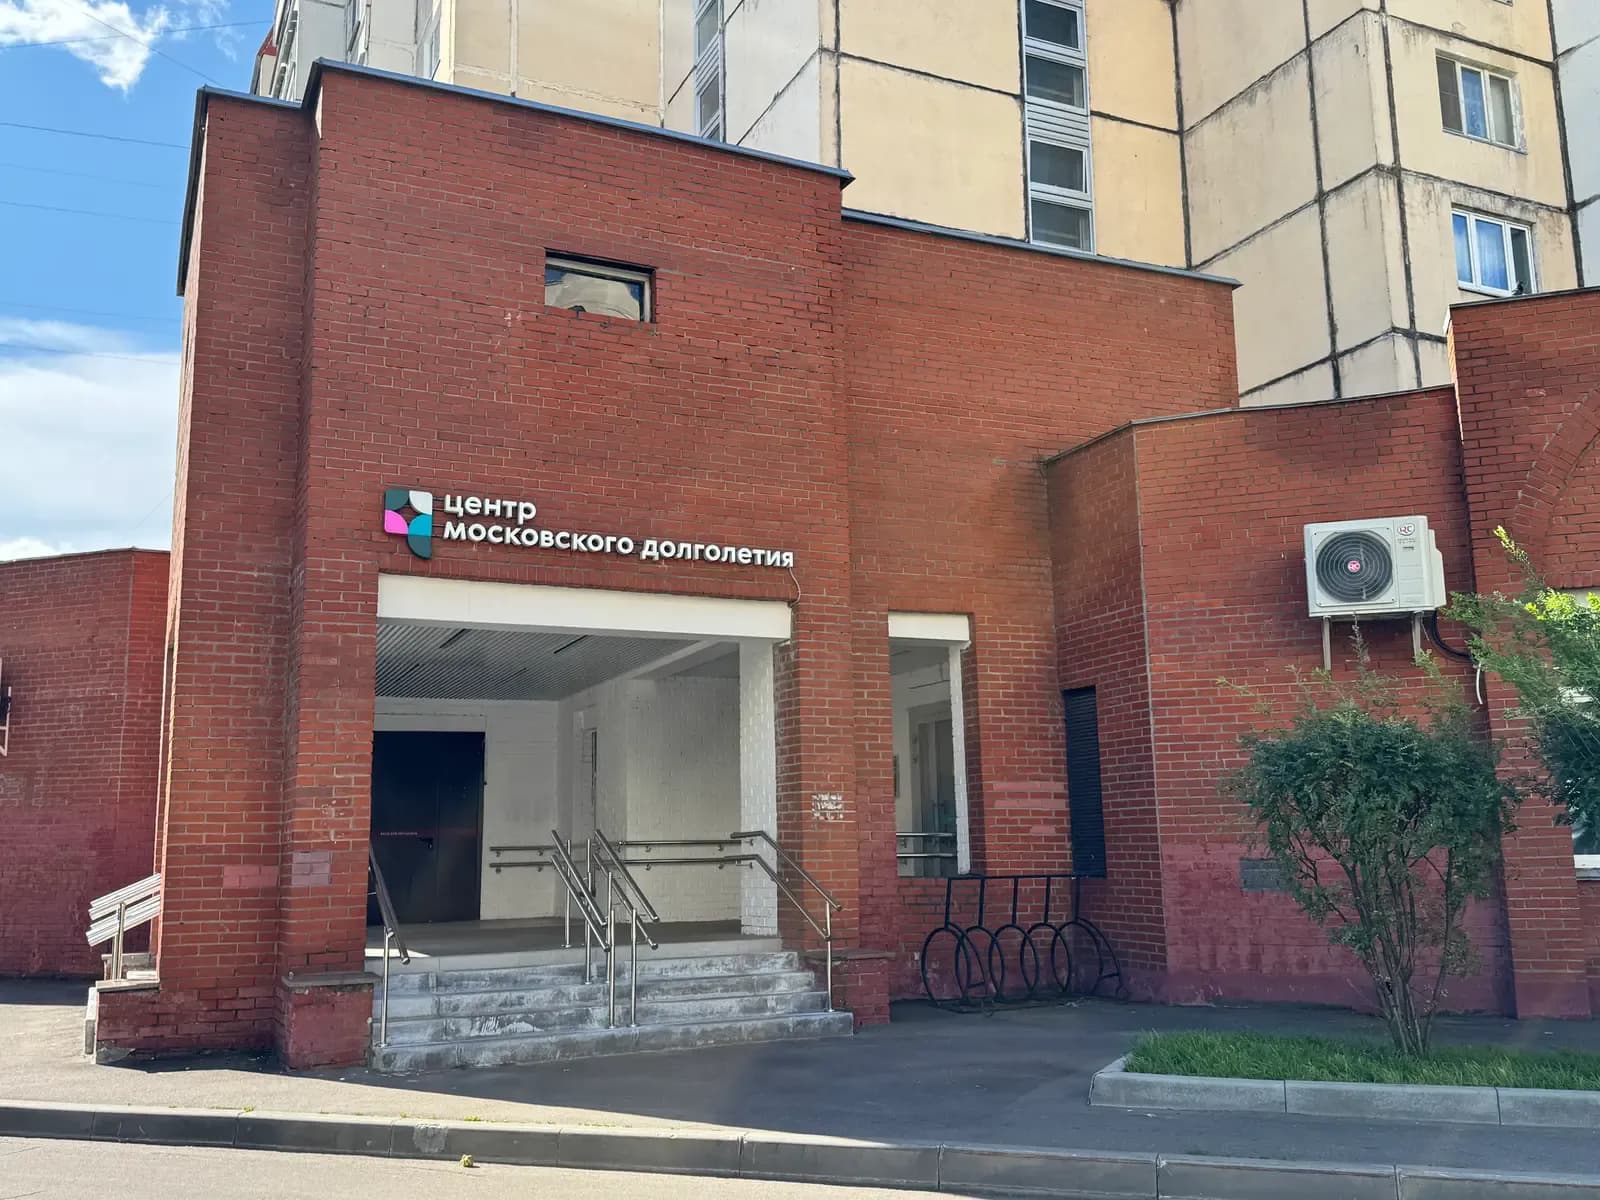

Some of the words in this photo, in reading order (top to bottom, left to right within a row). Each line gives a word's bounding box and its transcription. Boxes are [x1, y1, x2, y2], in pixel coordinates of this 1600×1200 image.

[444, 493, 537, 524] центр
[443, 521, 635, 556] московского
[641, 538, 794, 568] долголетия
